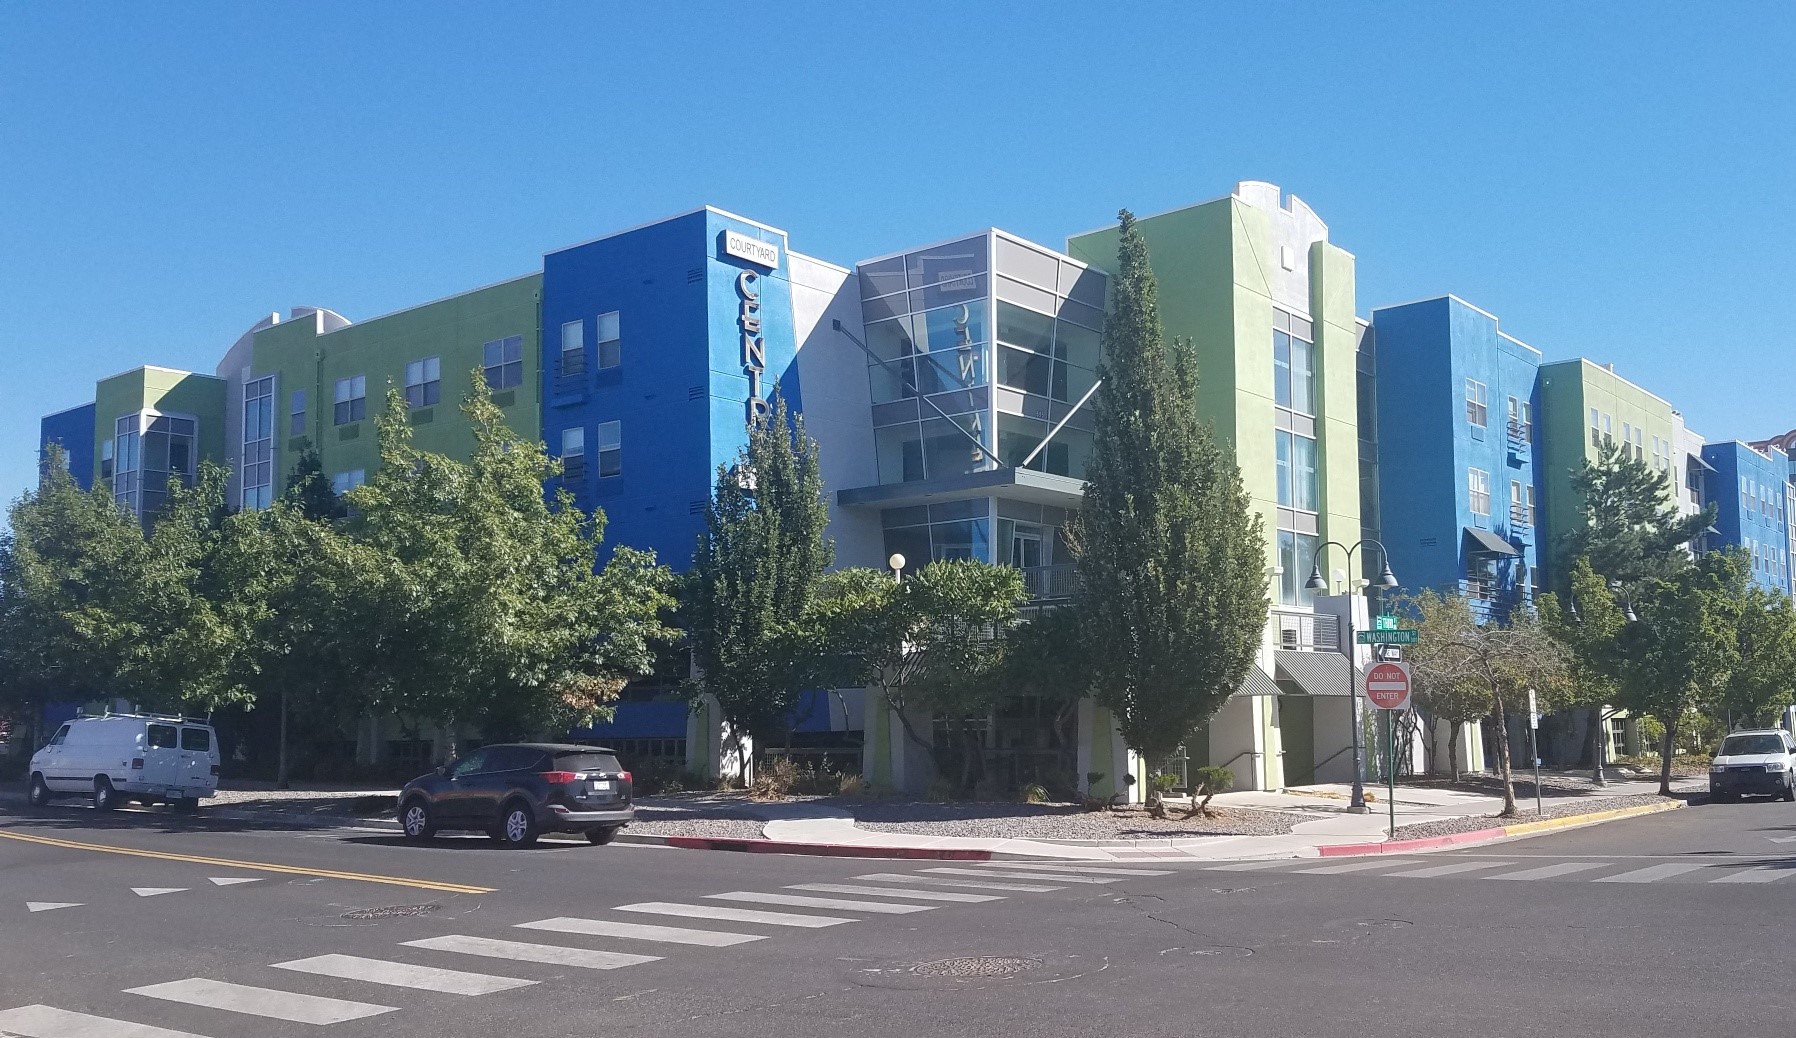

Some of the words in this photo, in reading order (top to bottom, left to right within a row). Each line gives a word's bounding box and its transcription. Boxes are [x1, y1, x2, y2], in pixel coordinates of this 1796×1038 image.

[730, 237, 775, 262] COURTYARD
[741, 269, 771, 429] CENTR
[1366, 631, 1410, 642] WASHINGTON
[1373, 672, 1384, 680] DO
[1386, 672, 1400, 680] NOT
[1376, 692, 1399, 700] ENTER
